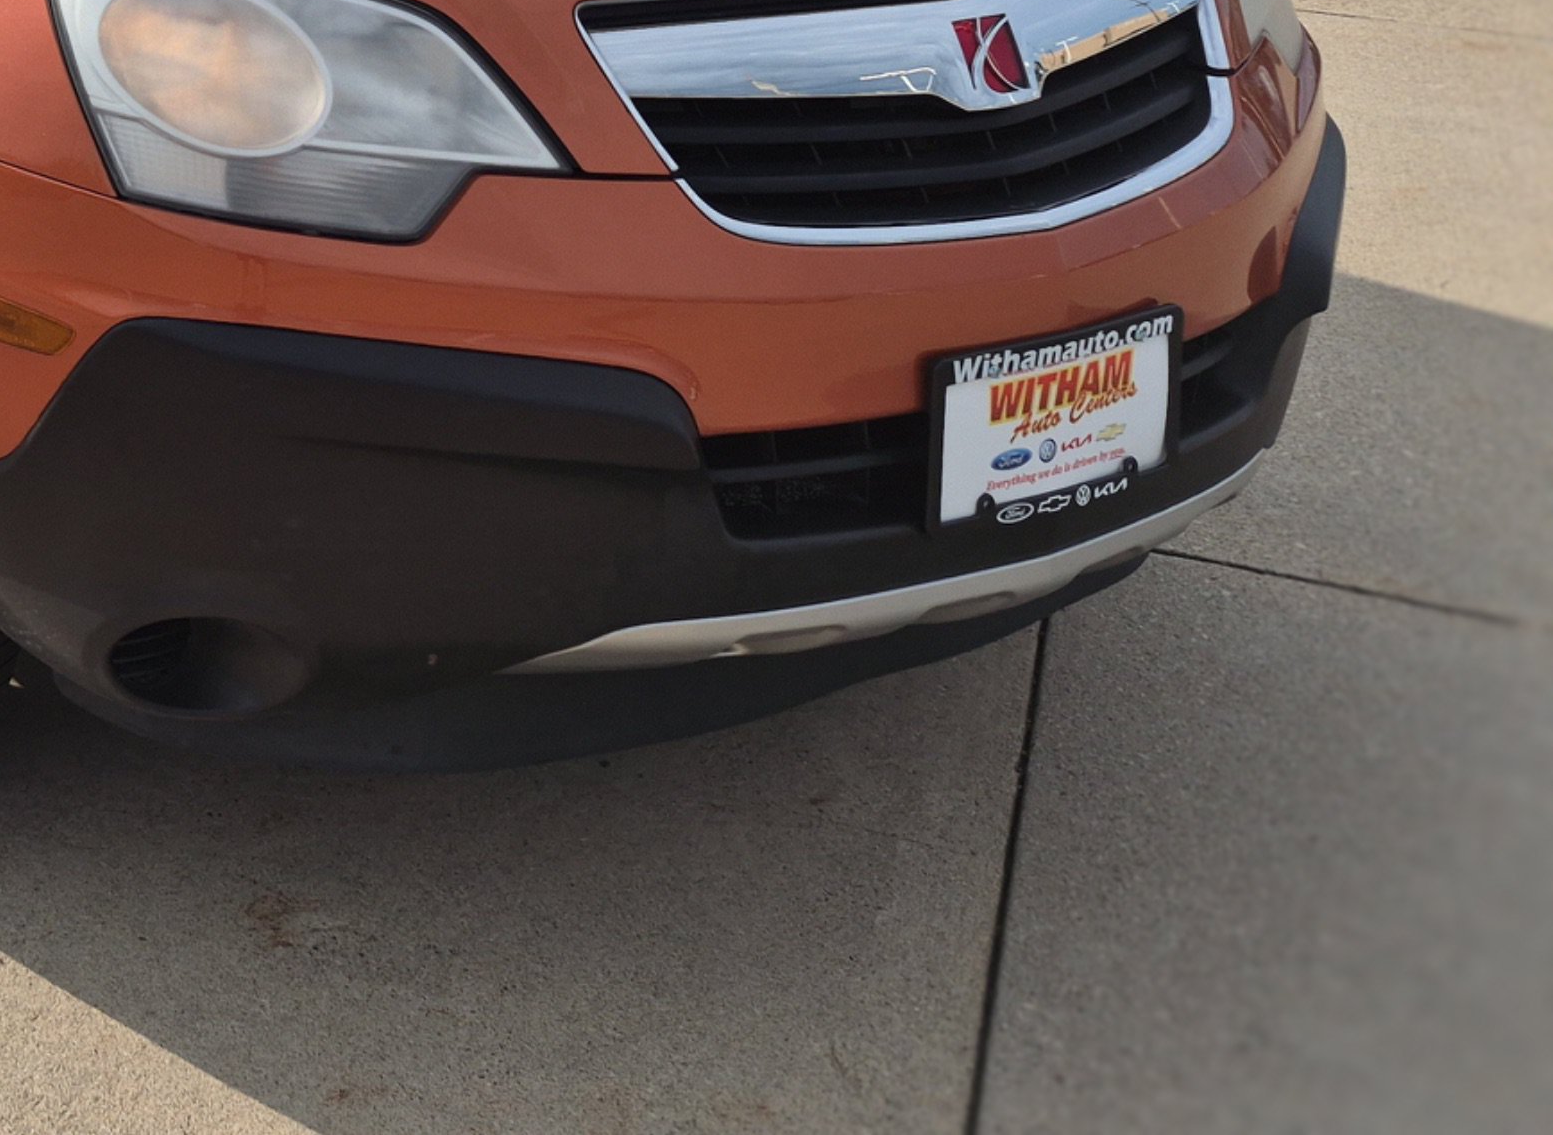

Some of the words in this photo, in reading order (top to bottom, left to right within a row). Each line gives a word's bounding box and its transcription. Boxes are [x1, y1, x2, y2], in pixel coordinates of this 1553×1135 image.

[953, 315, 1174, 384] Withamauto.com
[988, 349, 1135, 426] WITHAM
[1010, 412, 1061, 443] Auto
[1069, 381, 1138, 424] Centers
[987, 471, 1037, 491] Everything
[1038, 469, 1050, 479] we
[1052, 465, 1063, 476] do
[1073, 456, 1098, 470] driven
